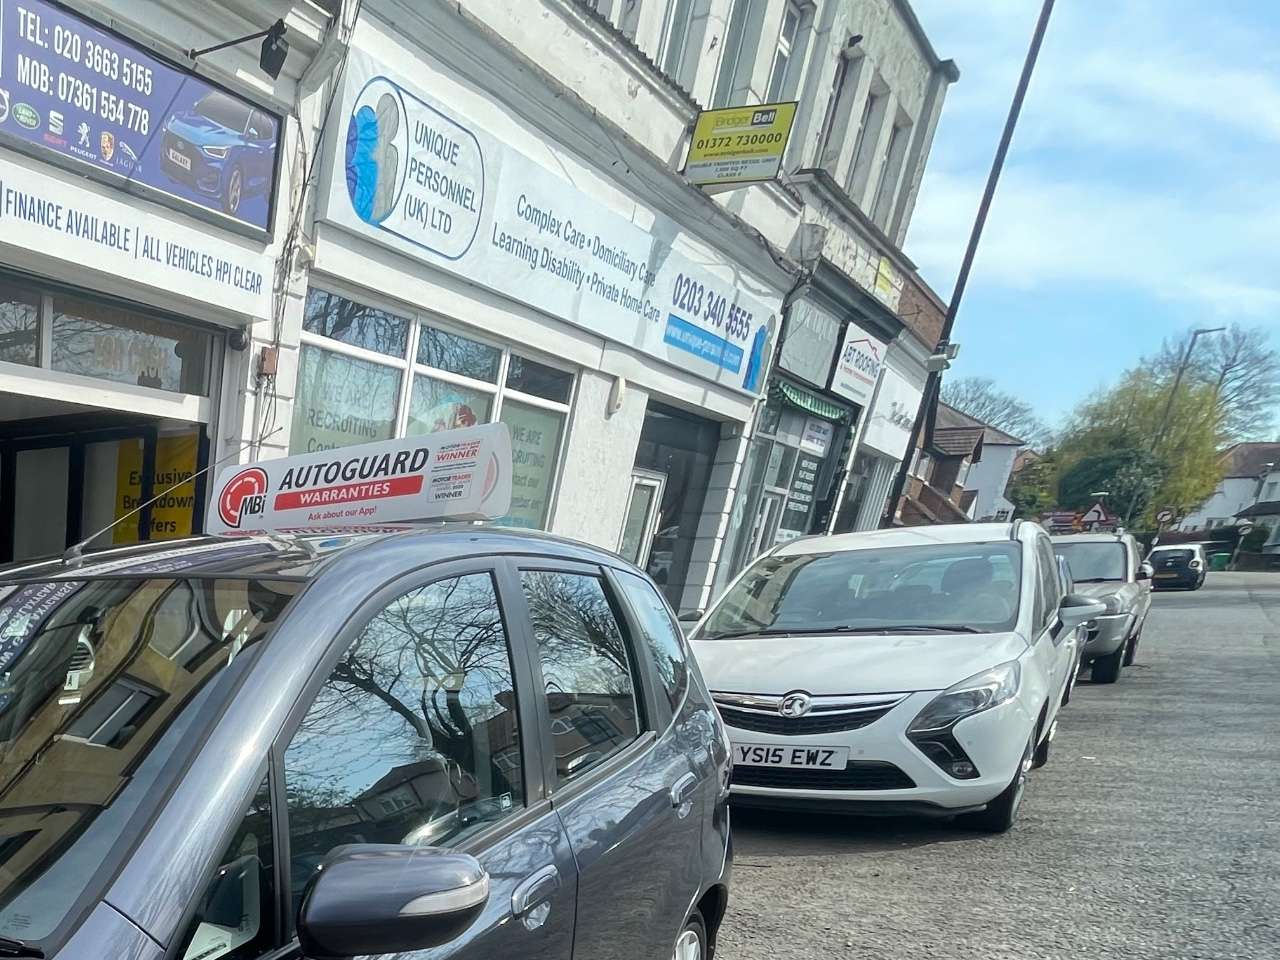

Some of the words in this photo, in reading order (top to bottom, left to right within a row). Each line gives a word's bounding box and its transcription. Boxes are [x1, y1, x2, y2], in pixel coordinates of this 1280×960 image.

[17, 7, 48, 49] TEL:
[54, 25, 80, 63] 020
[85, 40, 119, 80] 3663
[122, 60, 153, 96] 5155
[17, 54, 53, 96] MOB:
[58, 72, 97, 114] 07361
[100, 91, 124, 125] 554
[127, 102, 150, 136] 778
[752, 111, 775, 124] Bell
[70, 146, 97, 161] PEUGEOT
[414, 119, 460, 167] UNIQUE
[696, 136, 732, 150] 01372
[736, 132, 783, 147] 730000
[409, 157, 477, 214] PERSONNEL
[403, 193, 429, 230] (UK)
[431, 212, 453, 235] LTD
[5, 188, 63, 230] FINANCE
[65, 208, 131, 252] AVAILABLE
[142, 235, 161, 262] ALL
[165, 242, 213, 279] VEHICLES
[215, 259, 232, 285] HPI
[233, 268, 263, 296] CLEAR
[516, 194, 562, 237] Complex
[563, 220, 585, 250] Care
[638, 264, 656, 288] Care
[491, 222, 540, 271] Learning
[540, 247, 585, 291] Disability
[590, 271, 620, 303] Private
[620, 289, 643, 314] Home
[643, 302, 661, 323] Care
[672, 273, 703, 317] 0203
[703, 291, 726, 328] 340
[726, 304, 753, 341] 5555
[307, 407, 377, 439] RECRUITING
[278, 448, 429, 491] AUTOGUARD
[436, 449, 478, 461] WINNER
[299, 482, 391, 505] WARRANTIES
[308, 511, 322, 521] Ask
[322, 509, 343, 520] about
[344, 509, 357, 518] our
[358, 505, 377, 518] App!
[434, 490, 463, 499] WINNER
[738, 746, 783, 763] YS15
[790, 748, 835, 767] EWZ
